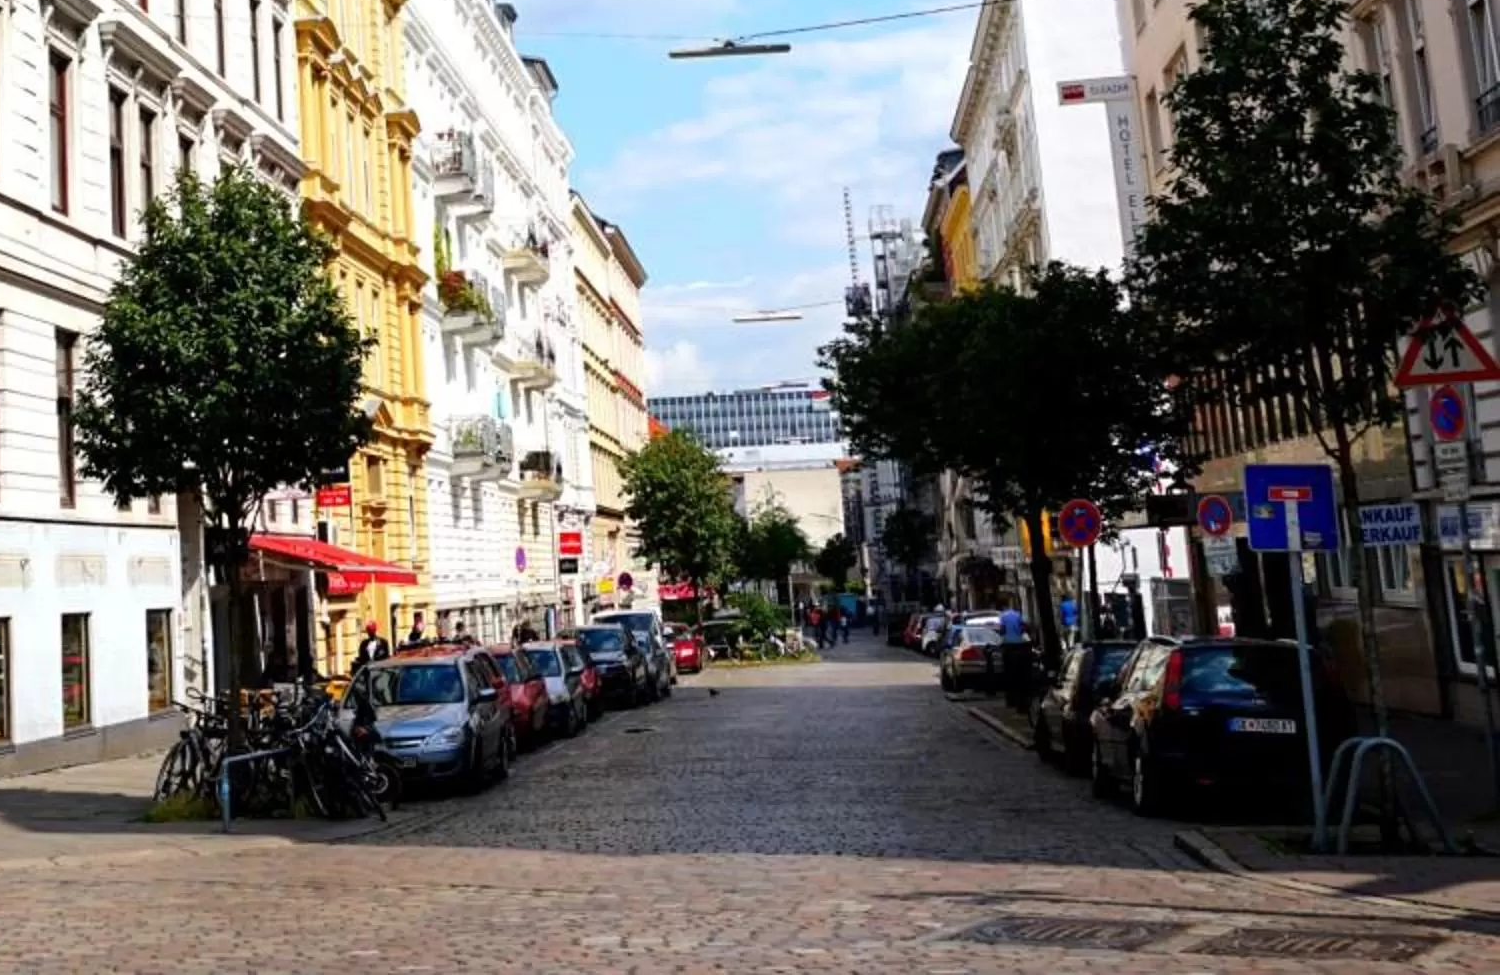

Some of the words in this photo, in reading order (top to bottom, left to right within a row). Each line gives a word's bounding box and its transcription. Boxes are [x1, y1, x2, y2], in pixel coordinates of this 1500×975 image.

[1117, 115, 1134, 185] HOTEL
[1362, 506, 1414, 523] NKAUF
[1363, 526, 1420, 543] ERKAUF
